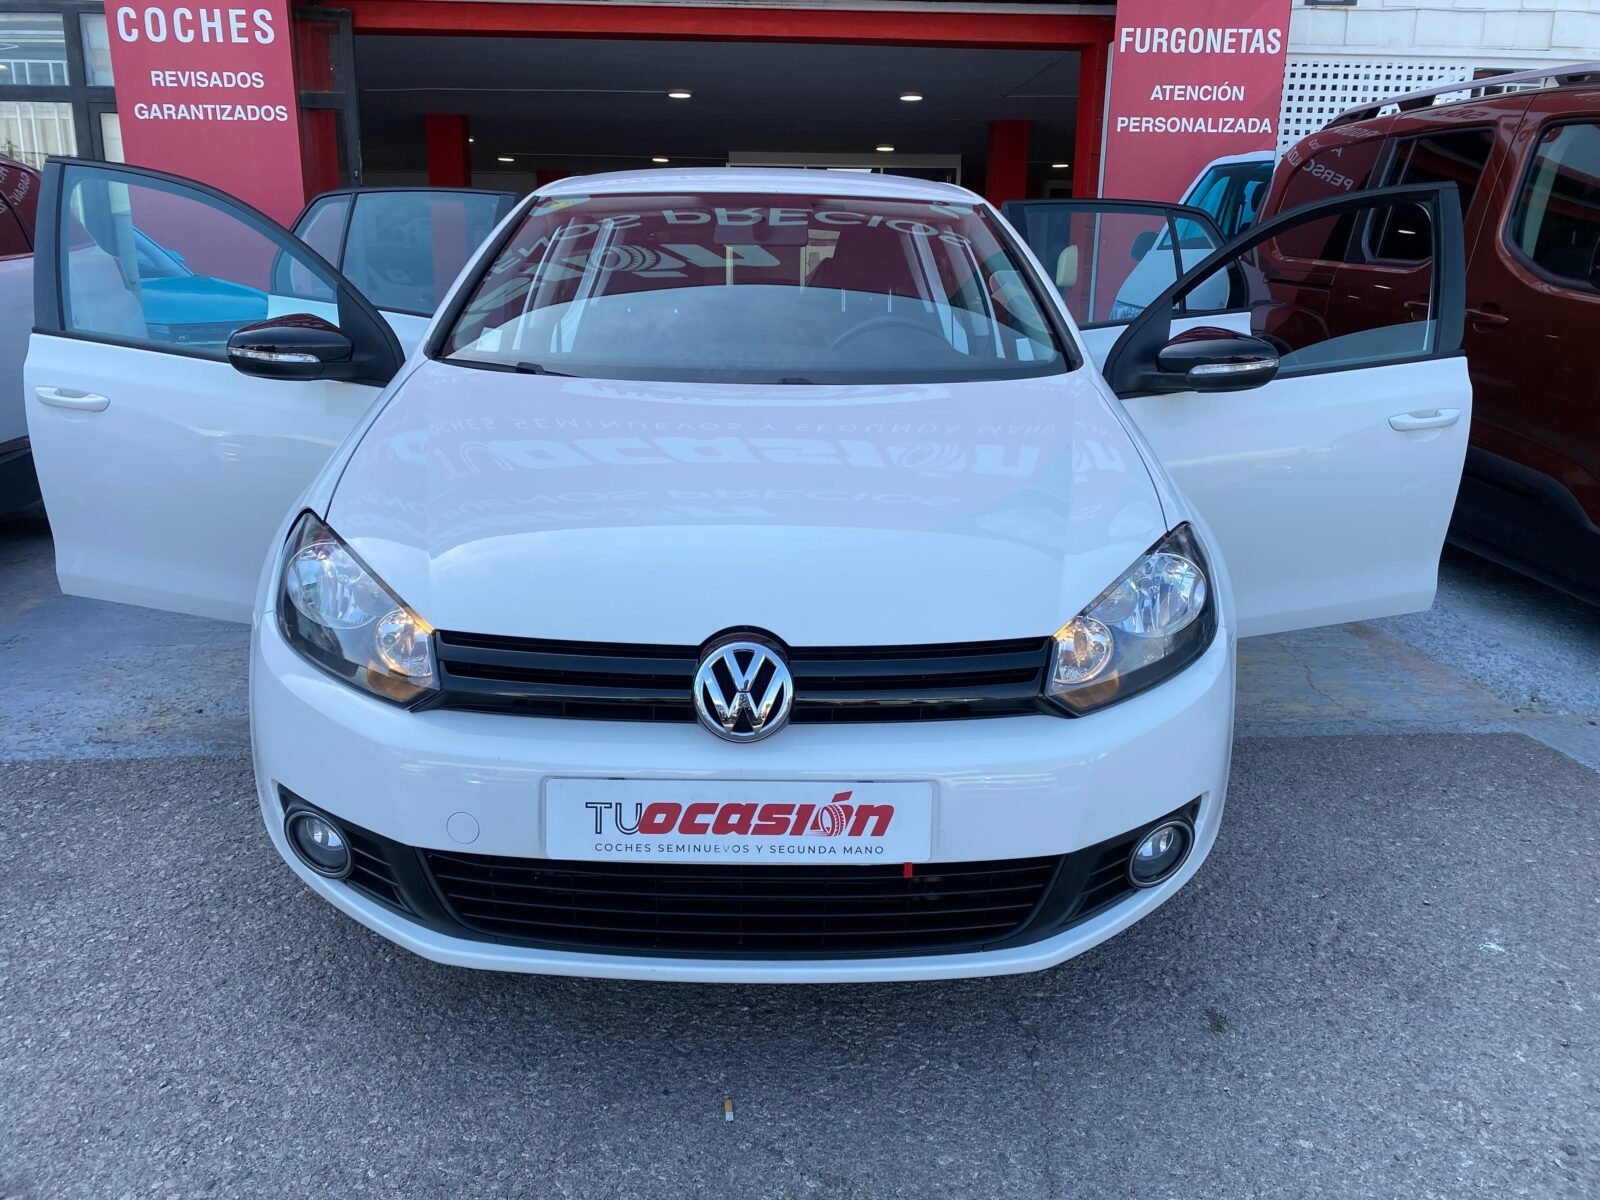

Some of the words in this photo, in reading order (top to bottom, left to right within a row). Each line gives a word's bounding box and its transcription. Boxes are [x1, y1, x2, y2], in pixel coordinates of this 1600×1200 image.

[116, 6, 275, 45] COCHES
[1119, 27, 1282, 54] FURGONETAS
[150, 70, 265, 89] REVISADOS
[1150, 81, 1245, 102] ATENCIÓN
[133, 103, 288, 122] GARANTIZADOS
[1116, 116, 1273, 134] PERSONALIZADA
[594, 842, 652, 854] COCHES
[657, 842, 750, 854] SEMINUEVOS
[756, 844, 763, 854] Y
[769, 844, 837, 855] SEGUNDA
[842, 844, 884, 855] MANO
